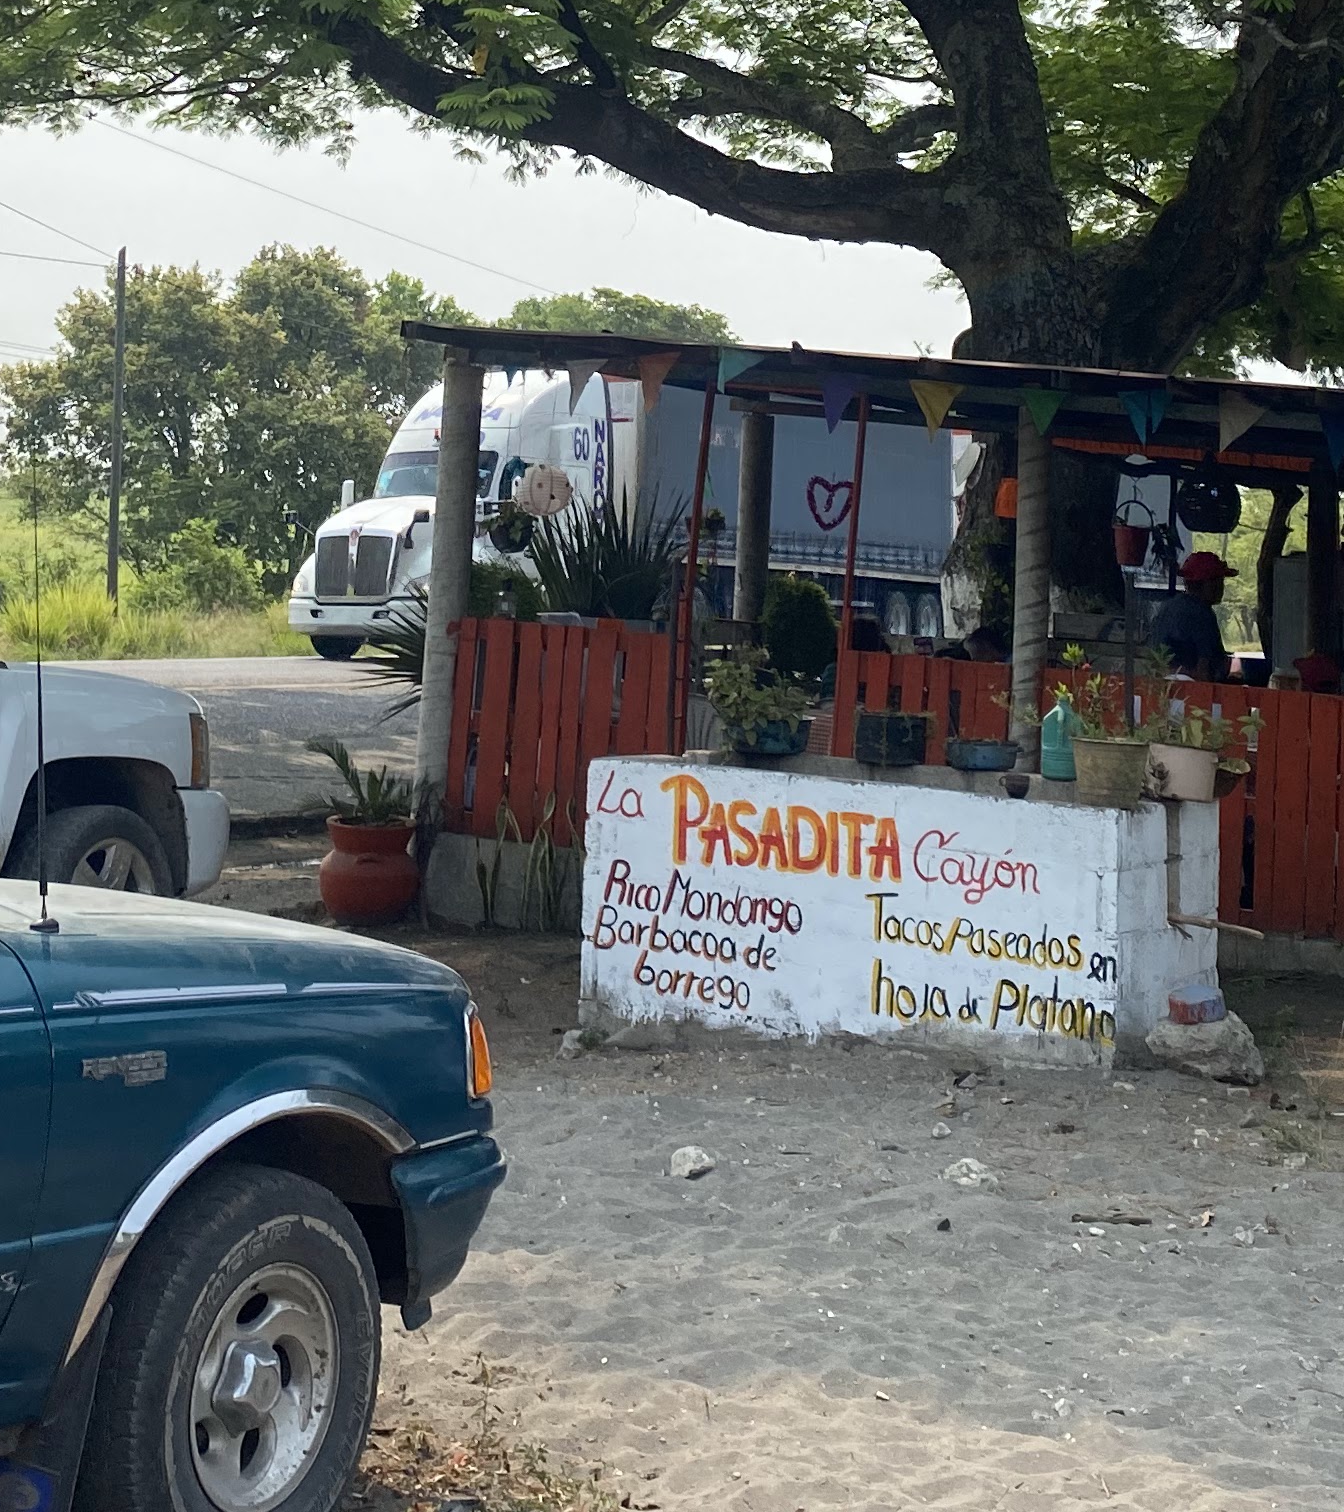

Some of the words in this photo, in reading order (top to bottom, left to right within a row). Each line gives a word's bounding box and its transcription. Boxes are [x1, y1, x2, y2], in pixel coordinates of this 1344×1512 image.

[573, 427, 590, 461] 60
[596, 769, 645, 819] La
[659, 774, 902, 883] PASADITA
[913, 829, 1041, 905] Cayón
[603, 859, 662, 912] Rico
[593, 904, 737, 964] Barbacoa
[742, 934, 778, 971] de
[865, 892, 947, 954] Tacos
[942, 917, 1086, 972] Paseados
[1087, 952, 1118, 984] en
[633, 950, 751, 1011] borrego
